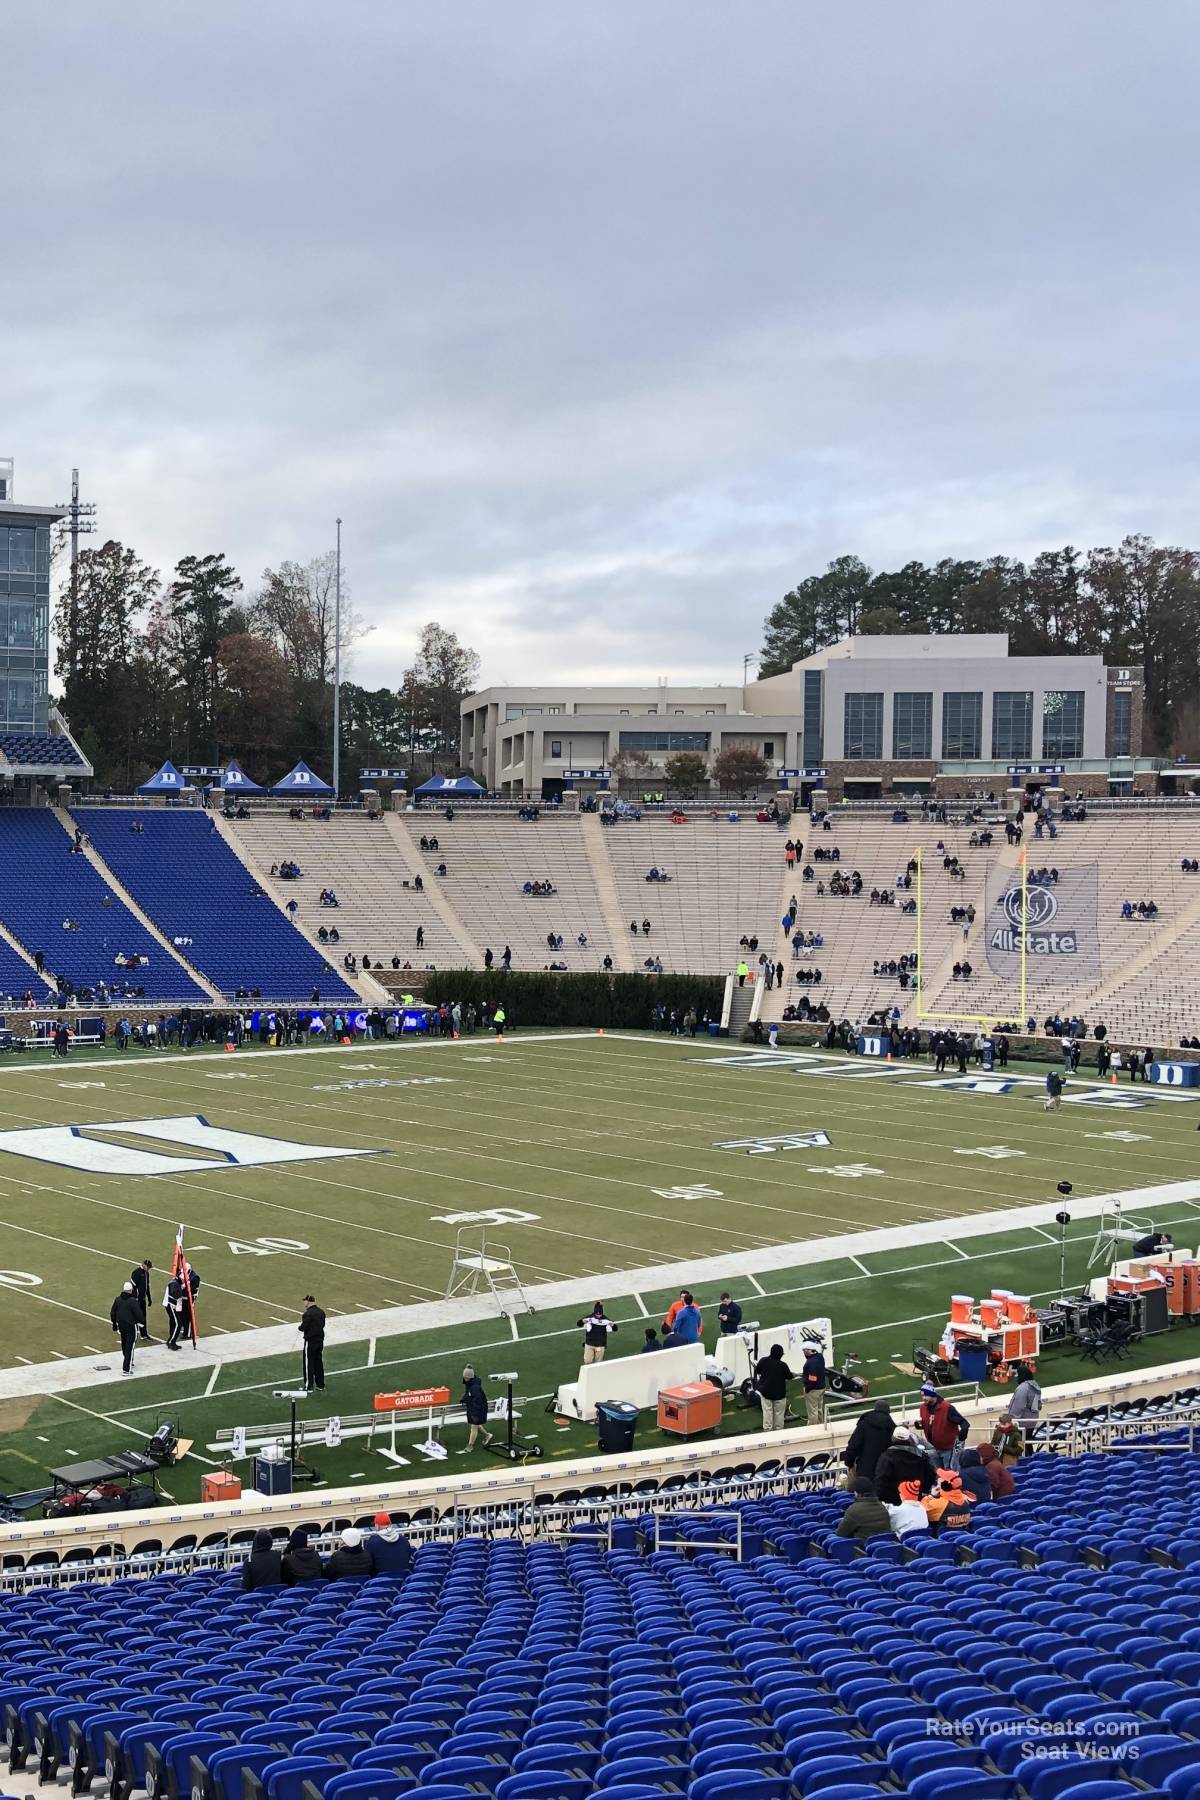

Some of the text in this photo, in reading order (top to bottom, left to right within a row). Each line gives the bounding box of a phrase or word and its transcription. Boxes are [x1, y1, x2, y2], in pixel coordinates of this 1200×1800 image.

[991, 929, 1075, 954] Allstate
[863, 1037, 881, 1056] D
[1156, 1064, 1183, 1086] D
[711, 1130, 833, 1155] ACC
[226, 1237, 311, 1257] 40
[394, 1394, 435, 1406] GATORADE
